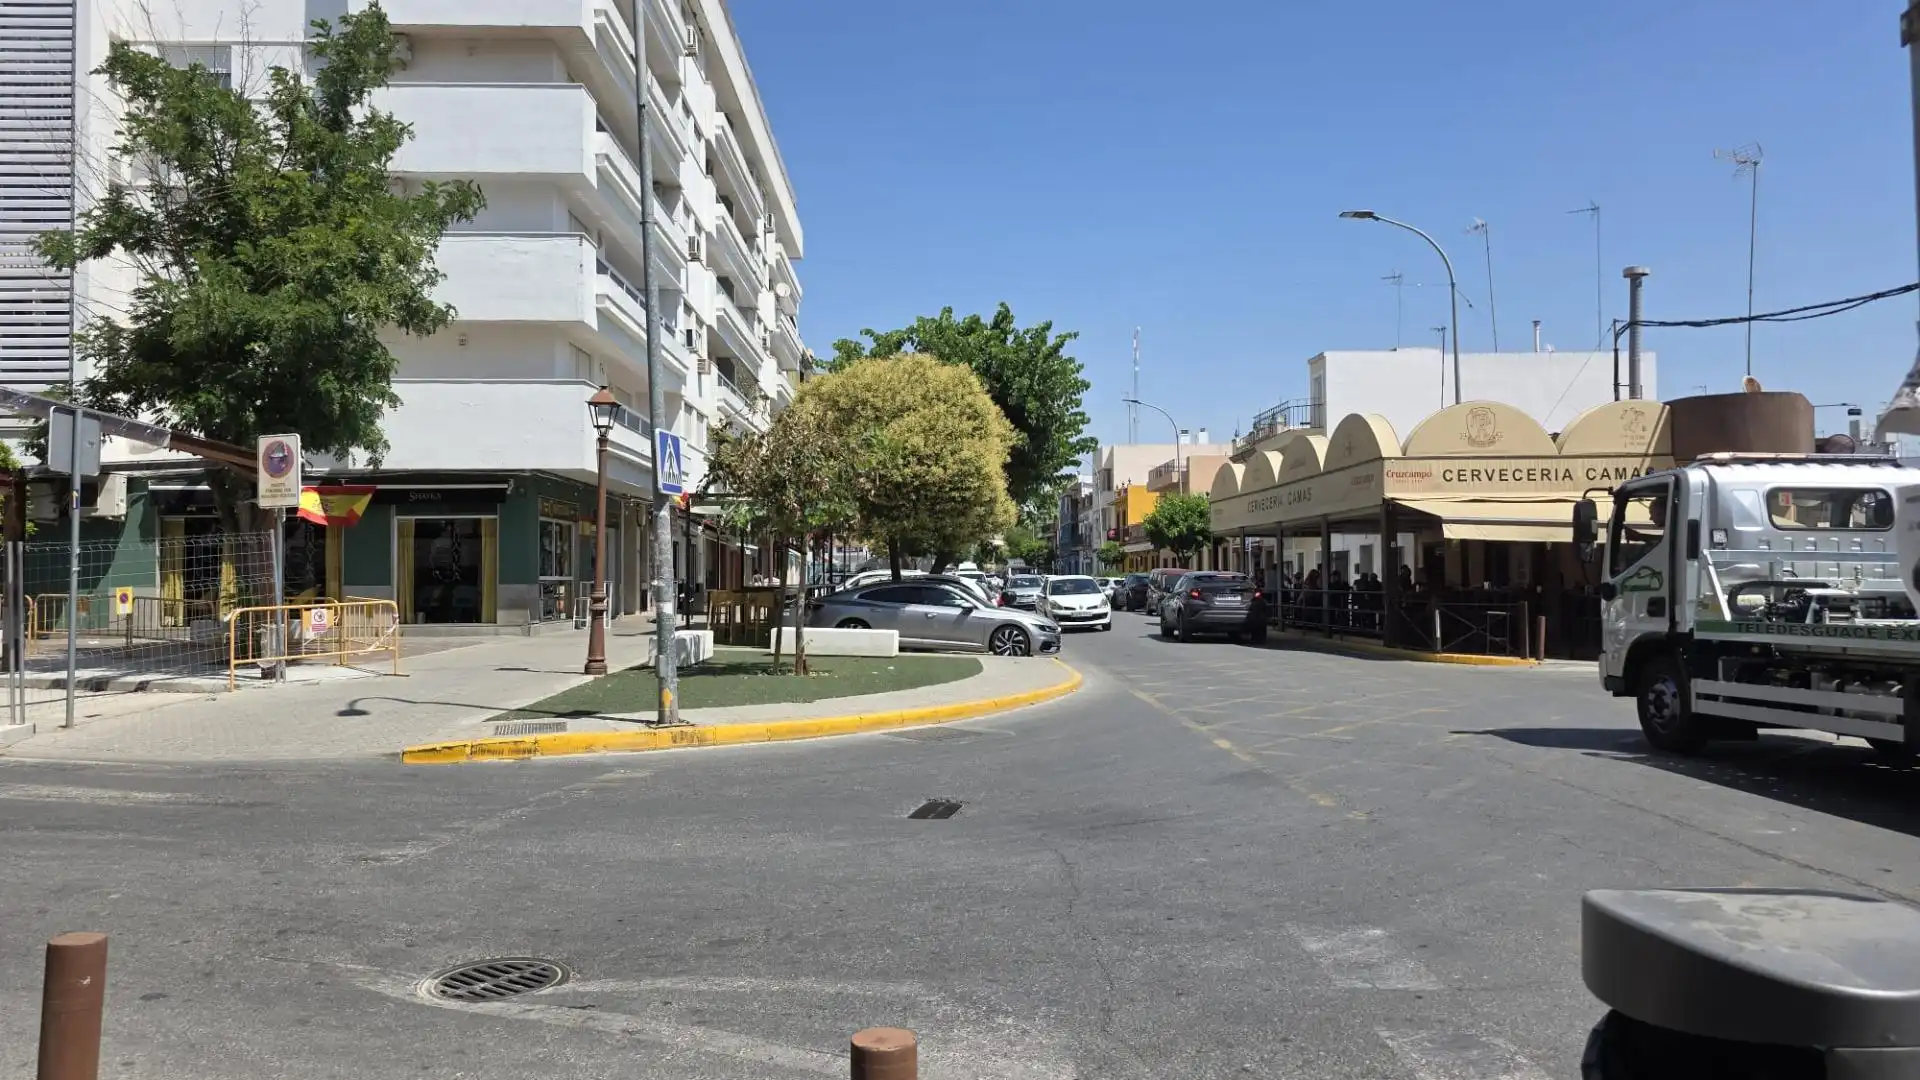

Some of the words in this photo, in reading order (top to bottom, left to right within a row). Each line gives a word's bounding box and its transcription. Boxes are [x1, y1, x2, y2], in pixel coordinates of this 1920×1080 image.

[1442, 468, 1573, 482] CERVECERIA
[1288, 487, 1312, 506] CAMAS
[1736, 623, 1878, 639] TELEDESGUACE
[1887, 625, 1920, 641] EX
